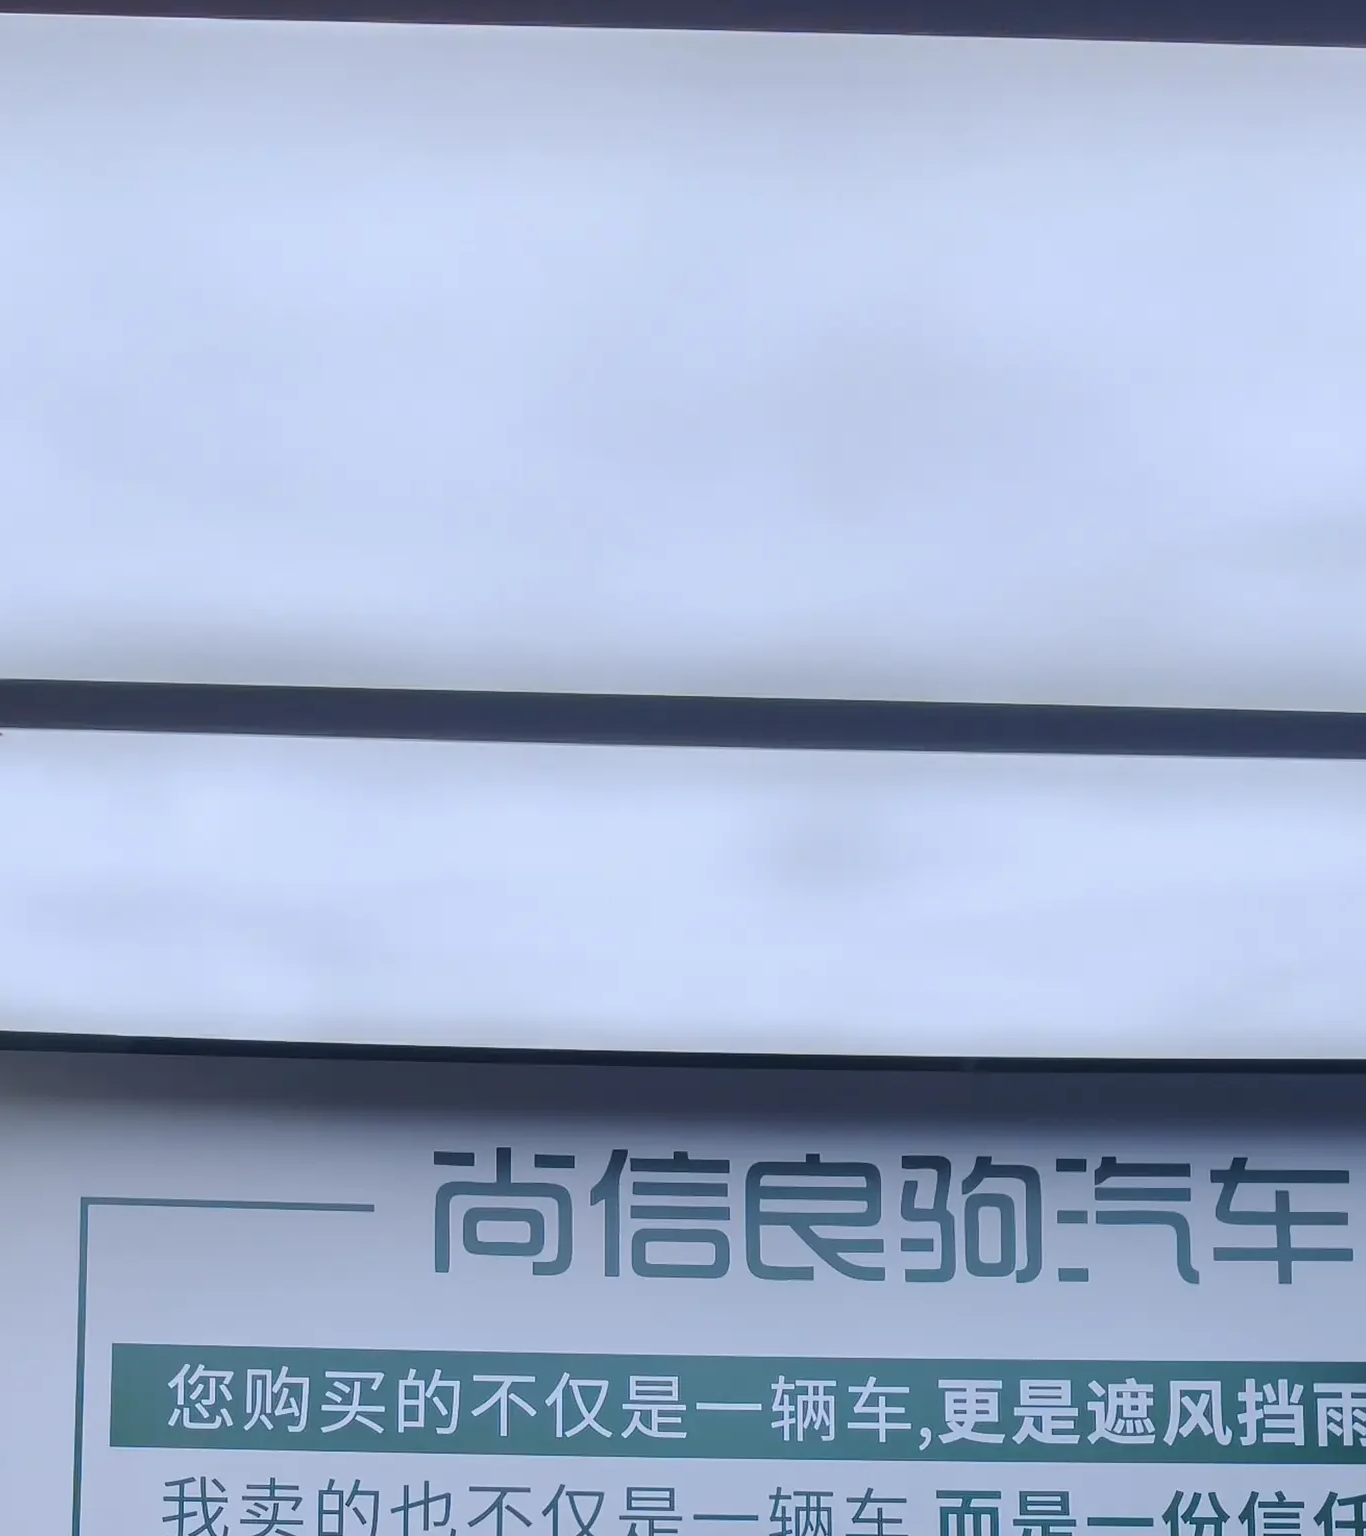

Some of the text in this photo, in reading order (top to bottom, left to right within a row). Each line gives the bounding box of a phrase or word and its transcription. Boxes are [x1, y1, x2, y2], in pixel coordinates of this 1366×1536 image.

[433, 1146, 1354, 1285] 尚信良驹汽车
